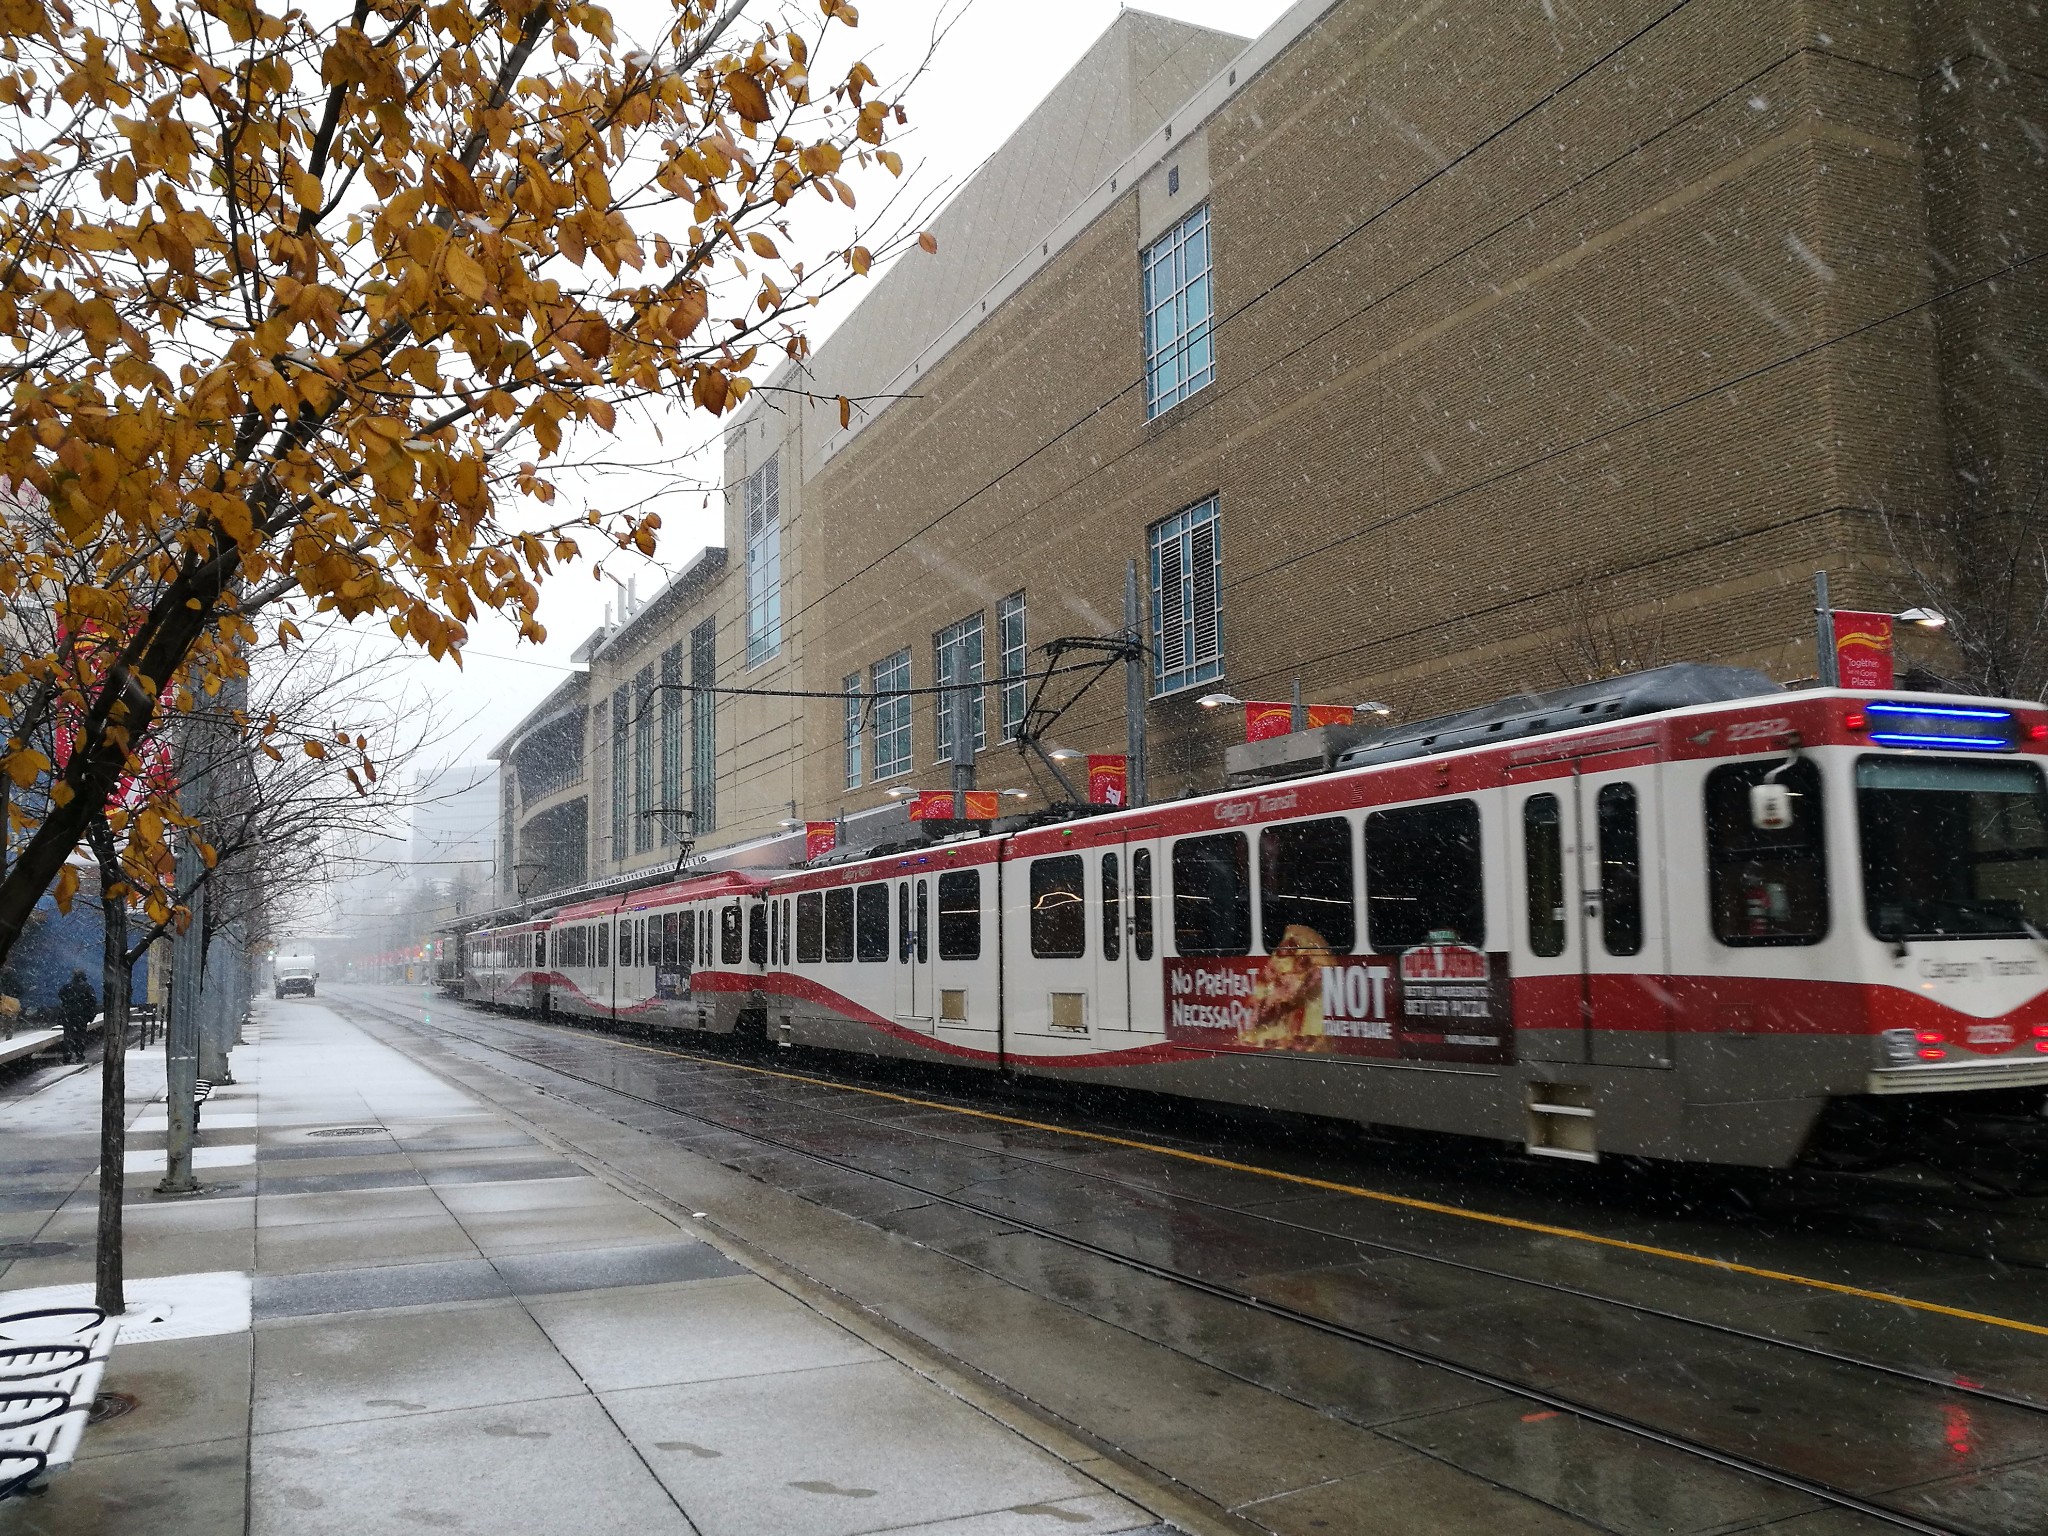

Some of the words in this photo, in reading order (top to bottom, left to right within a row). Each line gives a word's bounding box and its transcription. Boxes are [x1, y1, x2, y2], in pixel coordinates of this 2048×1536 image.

[1851, 677, 1877, 687] Places
[1727, 718, 1797, 742] 2252
[1213, 800, 1257, 823] Calgary
[1258, 789, 1298, 813] Transit
[1321, 965, 1391, 1019] NOT
